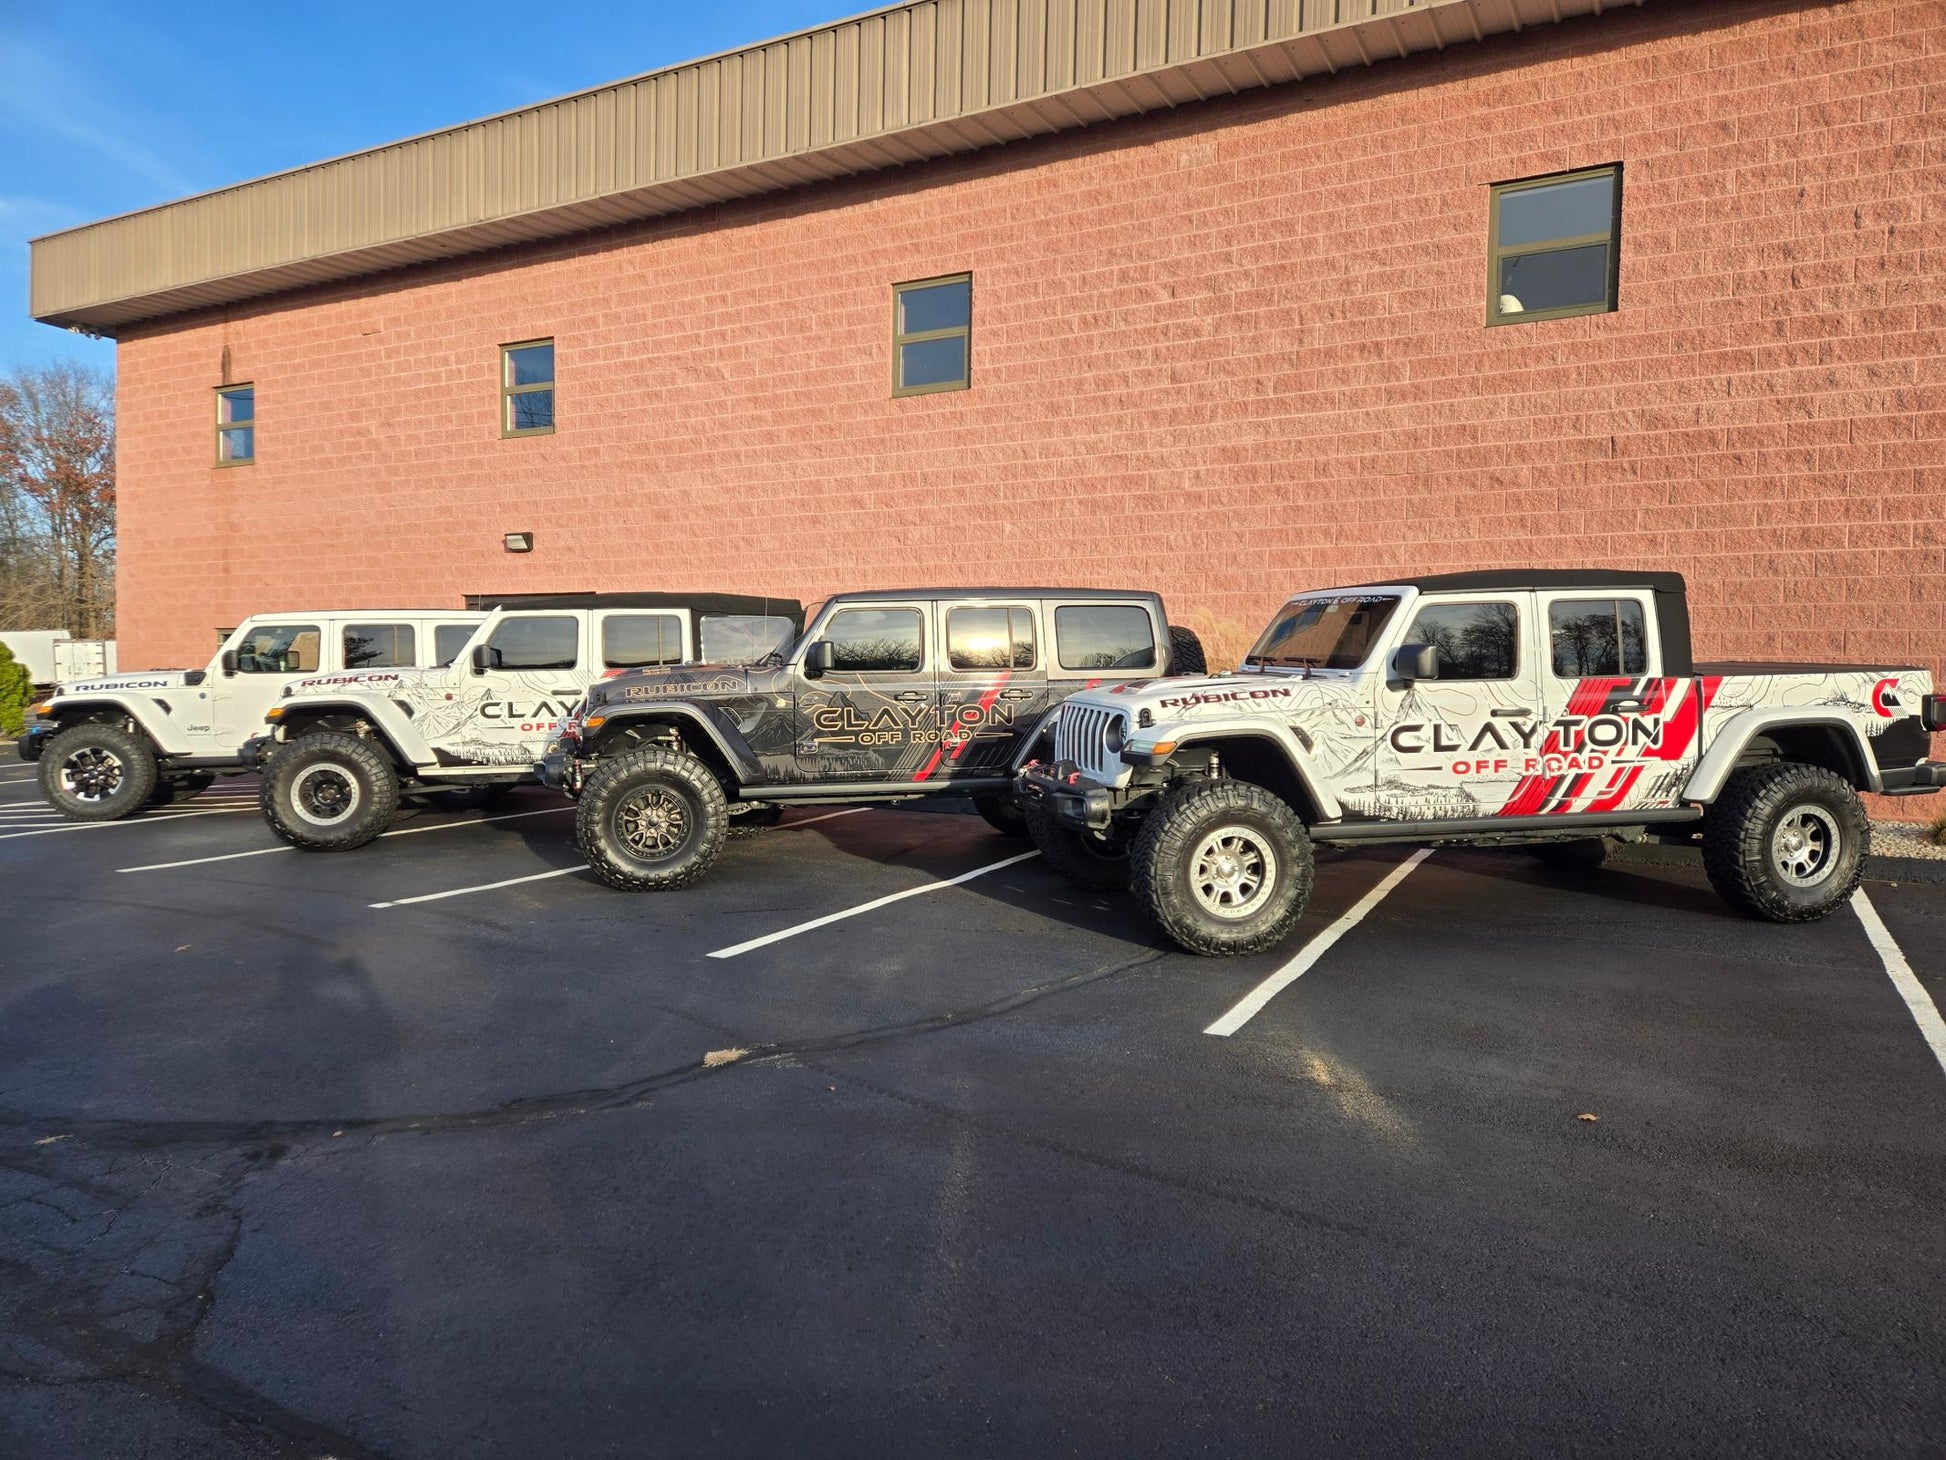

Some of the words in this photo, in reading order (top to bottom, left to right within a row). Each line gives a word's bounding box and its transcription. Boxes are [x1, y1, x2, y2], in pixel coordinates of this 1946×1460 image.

[75, 680, 168, 691] RUBICON
[301, 674, 399, 687] RUBICON
[625, 680, 738, 698] RUBICON
[1159, 688, 1292, 708] RUBICON
[480, 700, 581, 719] CLAY
[813, 704, 1014, 731] CLAYTON
[186, 724, 211, 732] Jeep
[520, 722, 558, 732] OFF
[1390, 717, 1661, 754] CLAYTON
[858, 731, 901, 745] OFF
[910, 729, 971, 744] ROAD
[1452, 759, 1508, 775] OFF
[1524, 755, 1604, 774] ROAD
